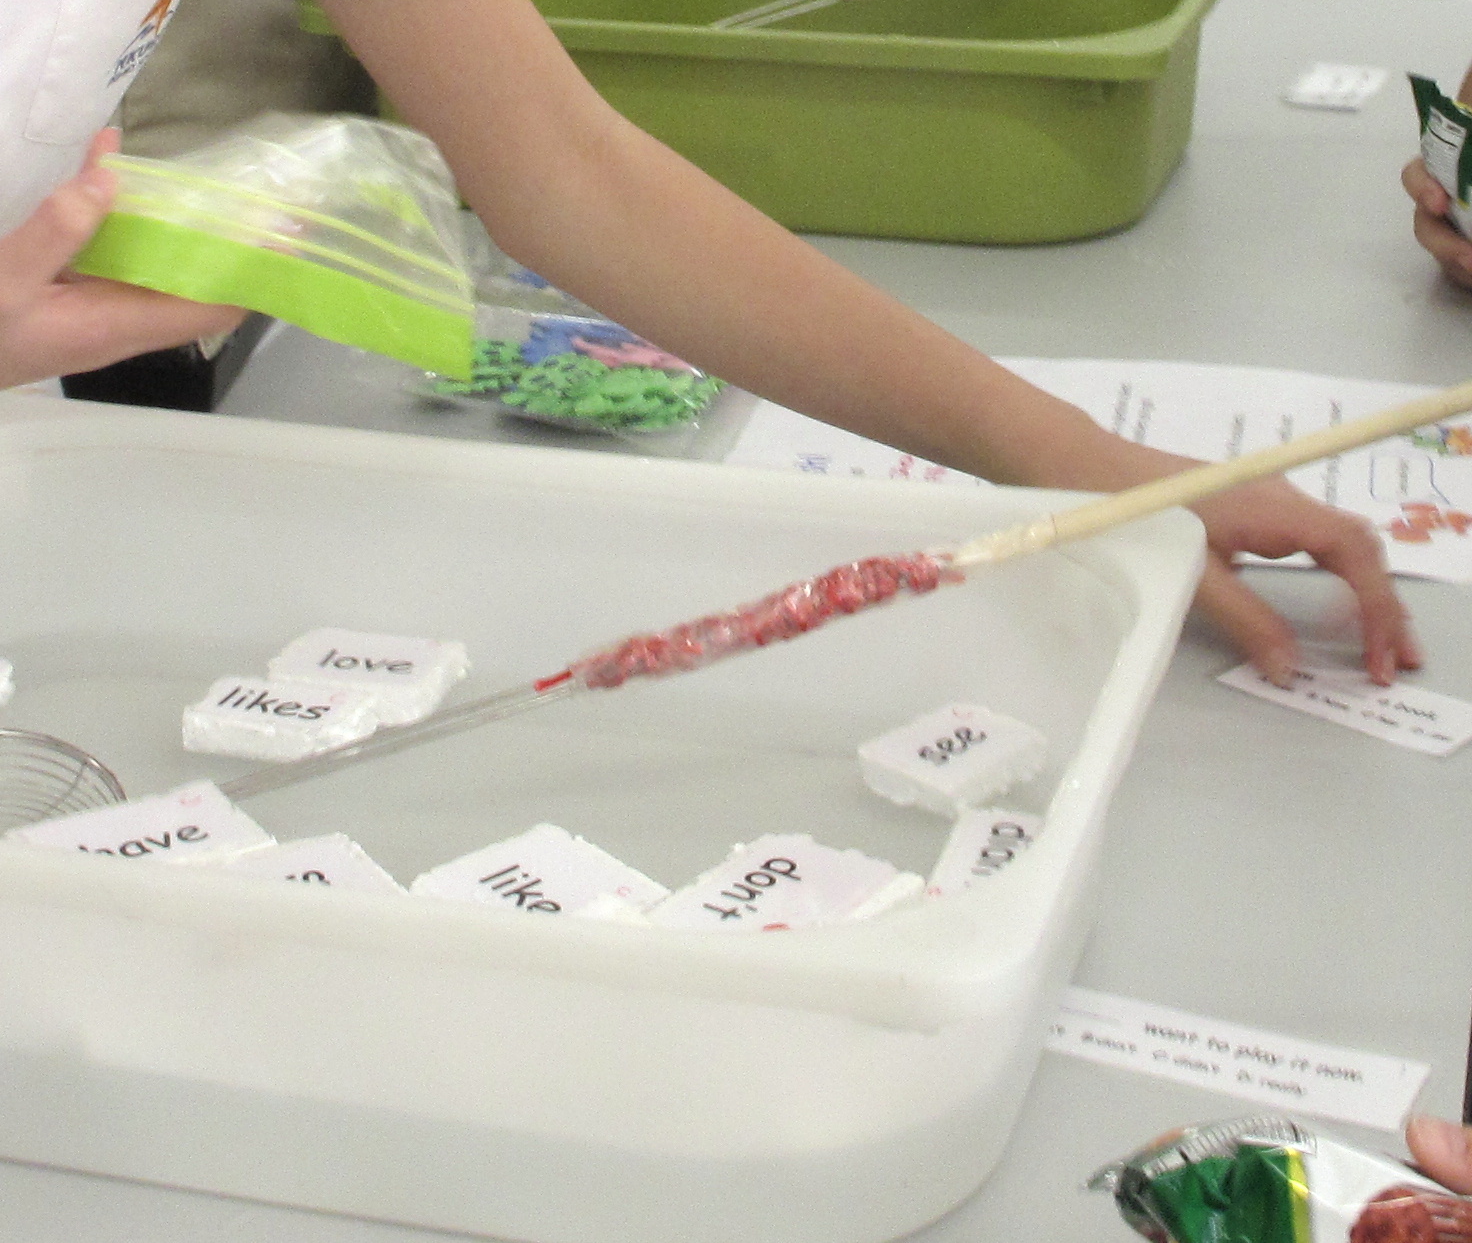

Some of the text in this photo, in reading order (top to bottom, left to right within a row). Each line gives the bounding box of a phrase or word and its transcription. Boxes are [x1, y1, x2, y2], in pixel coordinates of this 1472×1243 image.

[318, 647, 414, 676] love
[216, 686, 332, 722] likes
[917, 726, 987, 765] see
[478, 863, 563, 913] like
[703, 856, 802, 921] don't
